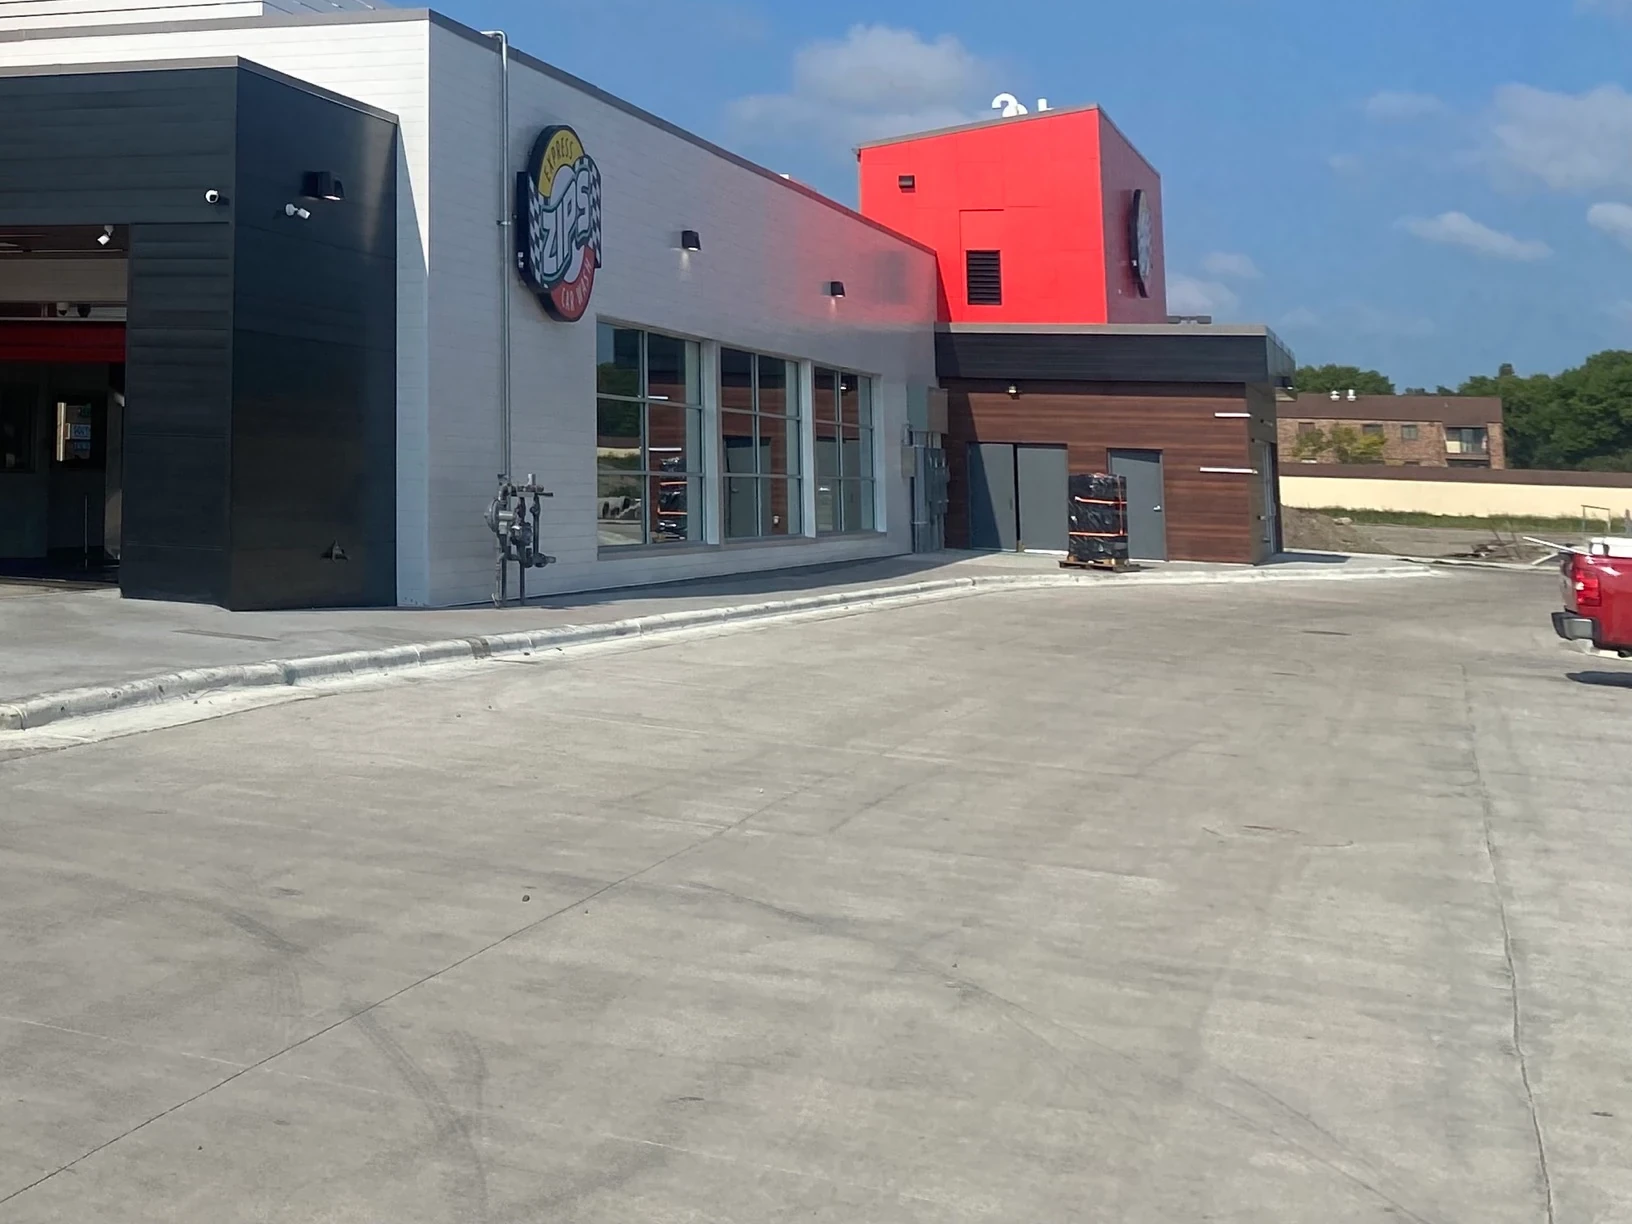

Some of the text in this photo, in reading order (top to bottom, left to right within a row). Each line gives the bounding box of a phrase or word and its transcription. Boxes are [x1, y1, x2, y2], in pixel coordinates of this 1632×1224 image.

[543, 137, 573, 183] EXPRESS
[541, 168, 590, 275] ZIPS
[561, 256, 593, 311] CAR WASH
